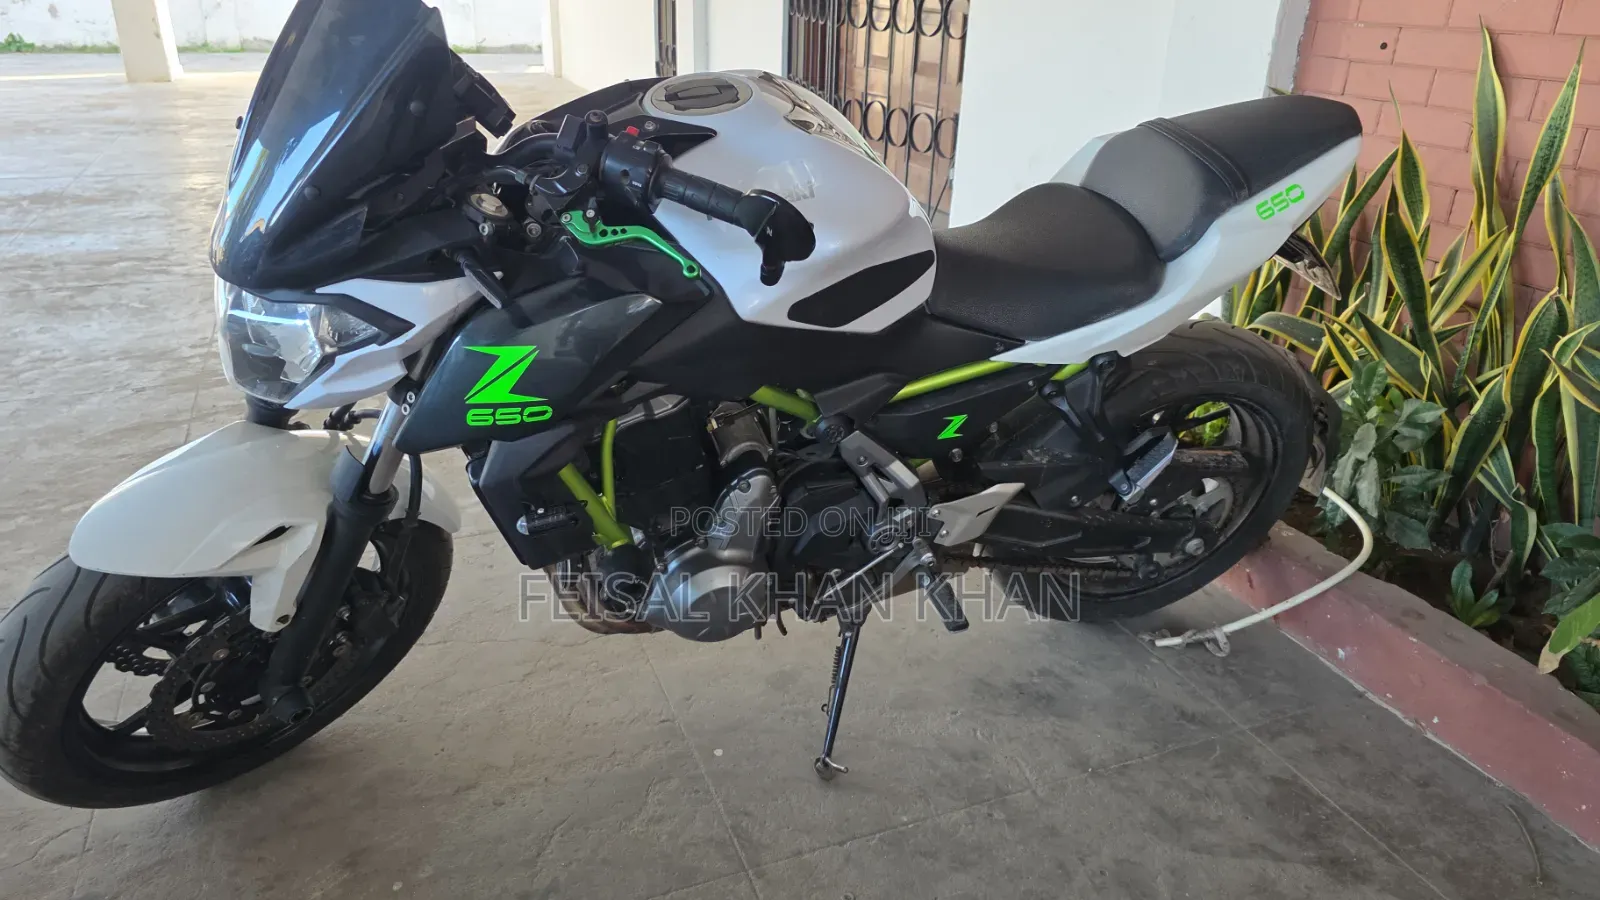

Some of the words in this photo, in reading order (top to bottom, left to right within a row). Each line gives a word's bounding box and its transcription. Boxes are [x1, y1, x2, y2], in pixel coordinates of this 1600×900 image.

[1256, 184, 1304, 220] 650
[462, 345, 548, 404] Z
[466, 405, 553, 426] 650
